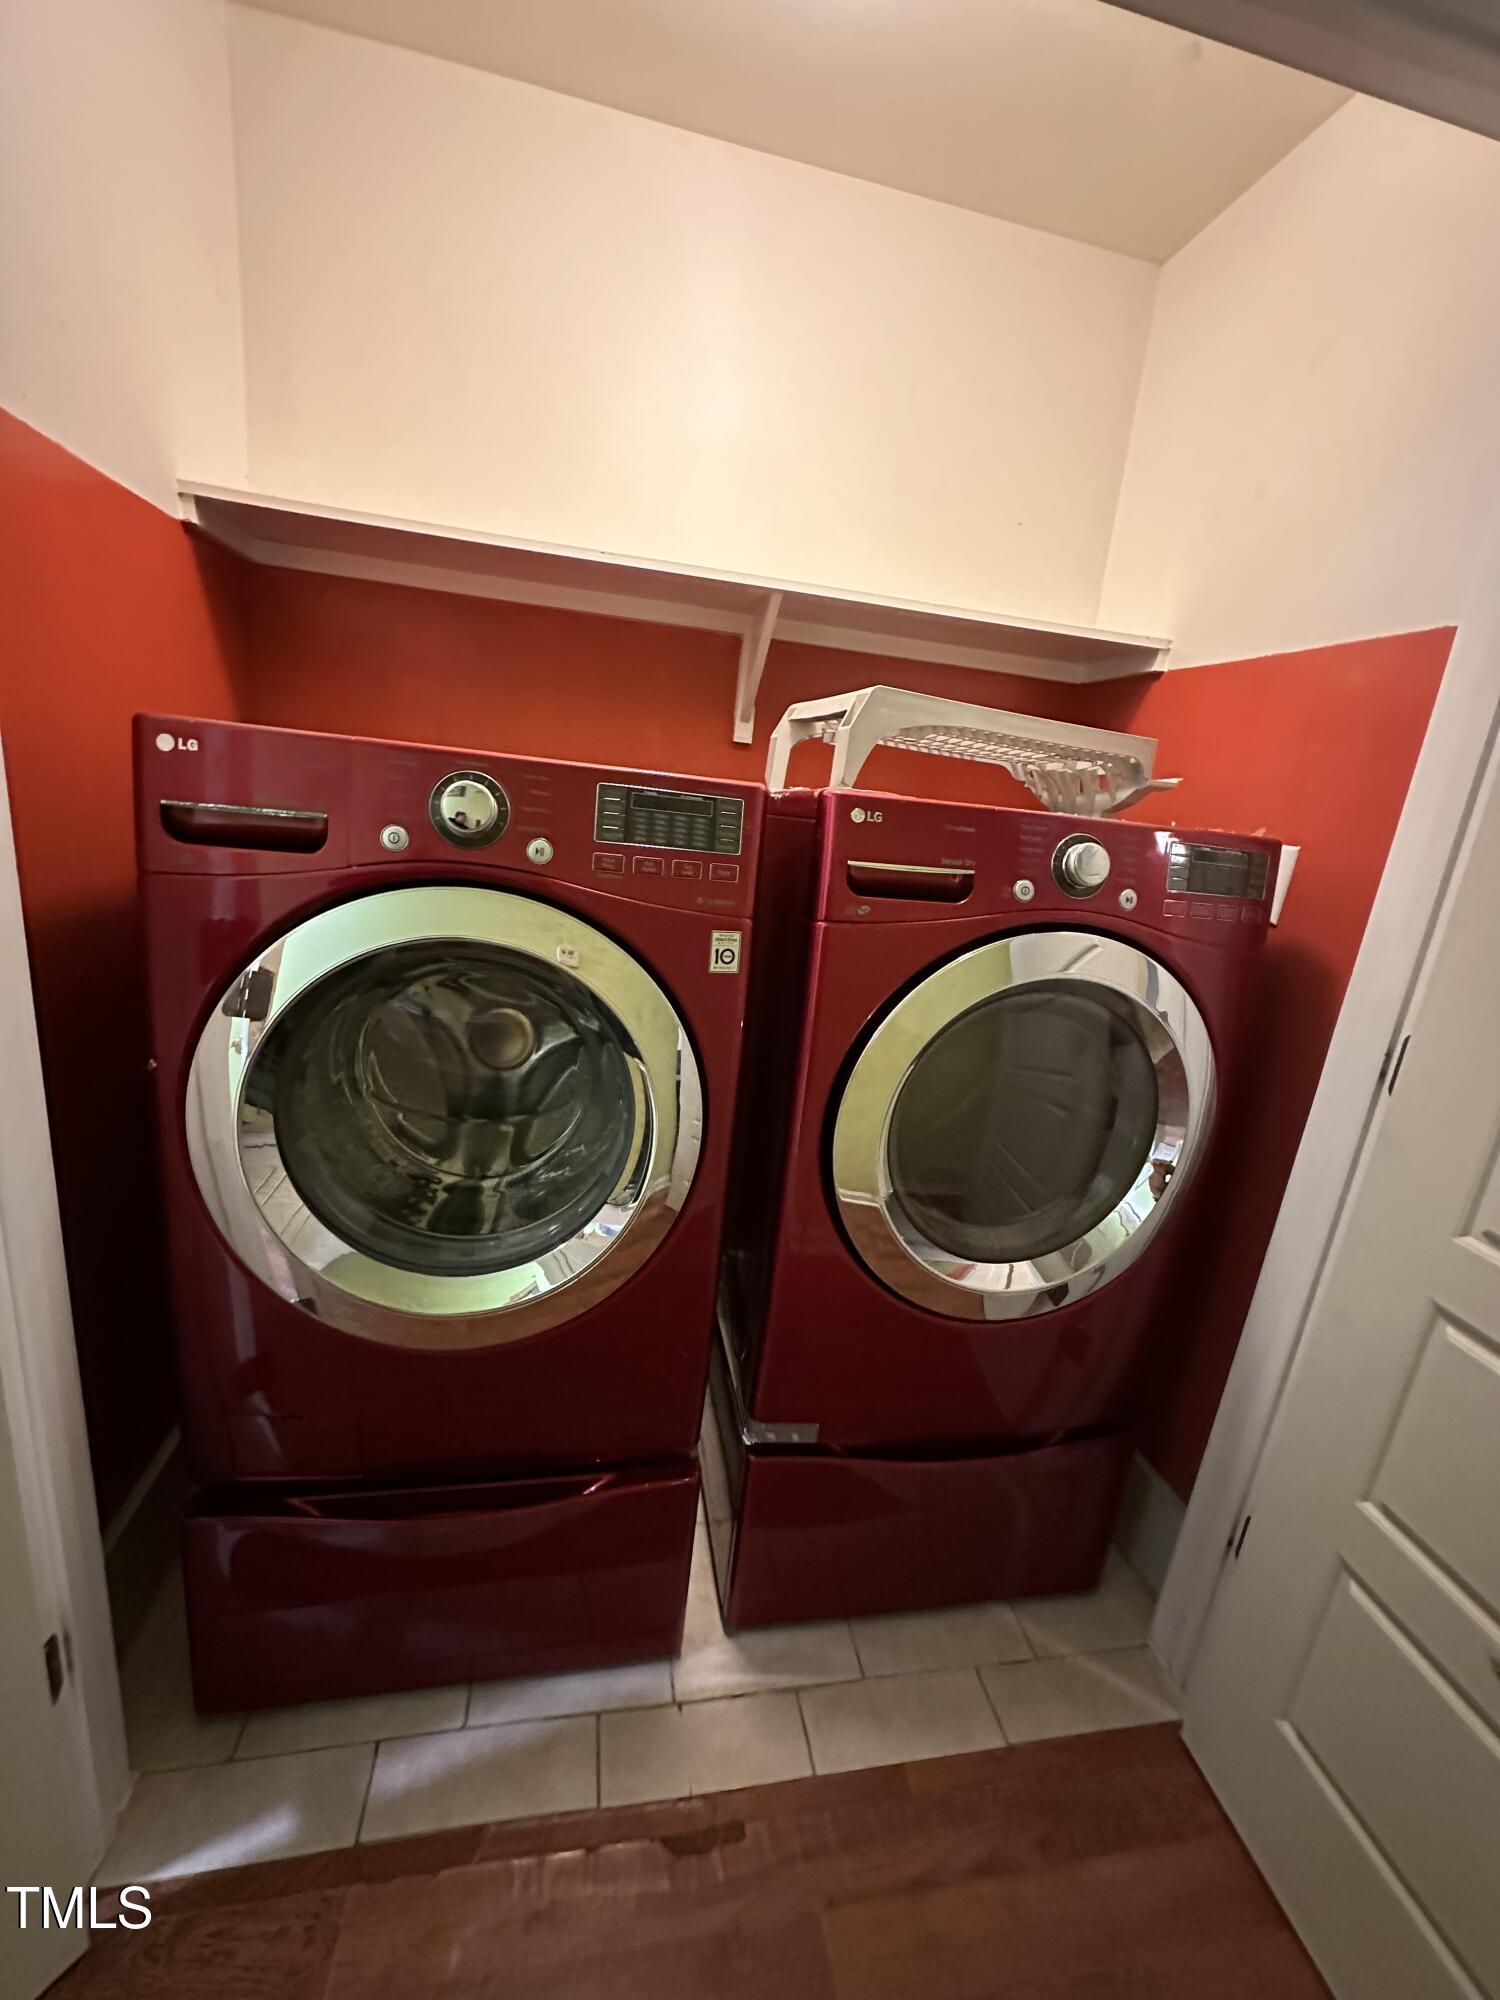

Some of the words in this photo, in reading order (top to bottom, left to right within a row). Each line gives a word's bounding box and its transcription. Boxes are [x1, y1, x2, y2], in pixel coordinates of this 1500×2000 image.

[178, 737, 199, 751] LG
[867, 811, 883, 823] LG
[715, 948, 735, 965] 10
